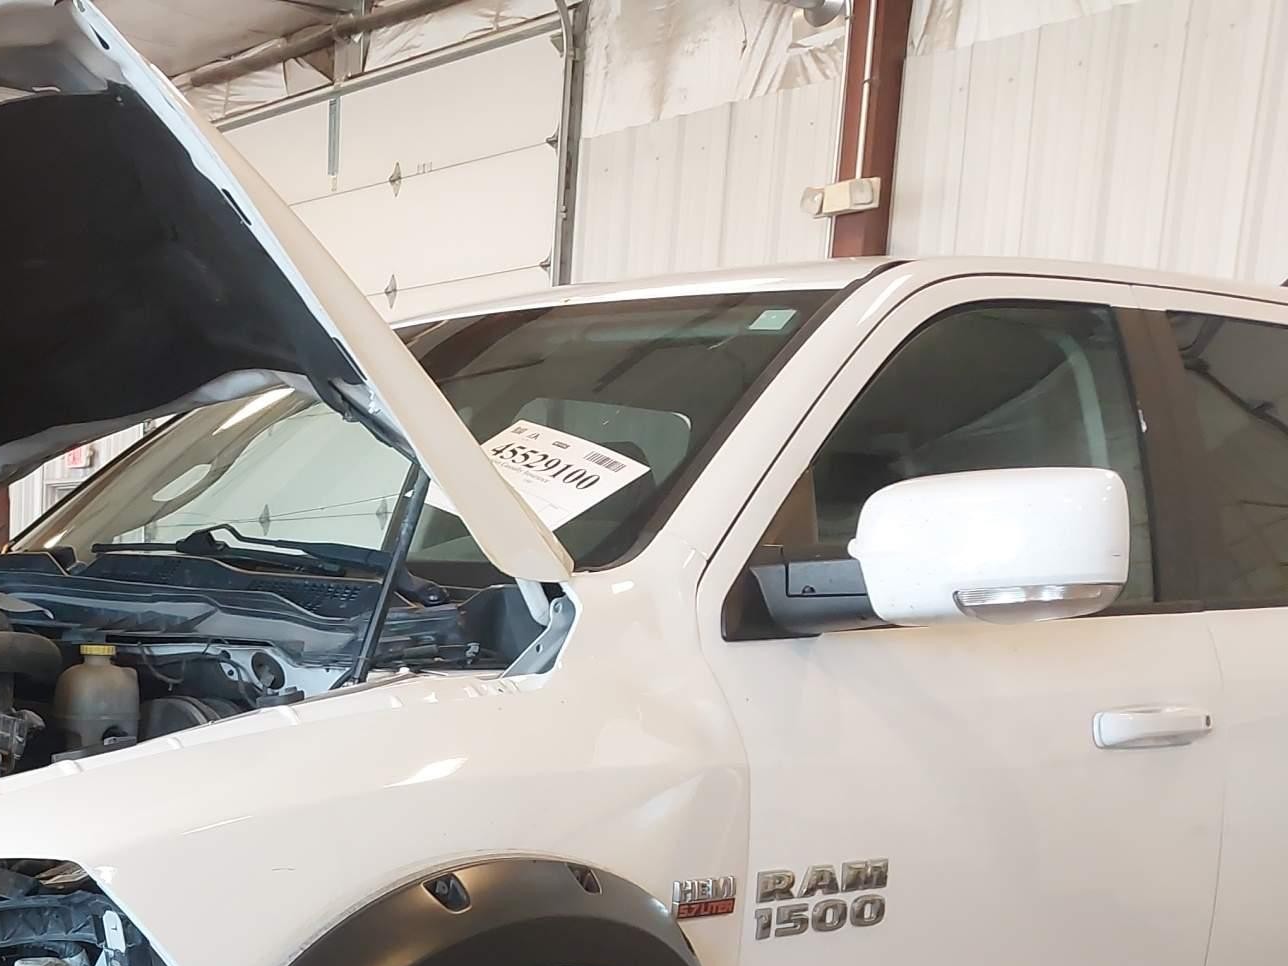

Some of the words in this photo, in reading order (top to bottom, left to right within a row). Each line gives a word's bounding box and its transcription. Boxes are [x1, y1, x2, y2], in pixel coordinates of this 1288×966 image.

[490, 442, 601, 490] 45529100
[673, 876, 736, 903] HEMI
[756, 858, 889, 903] RAM
[680, 904, 699, 917] 5.7
[700, 901, 733, 915] LITER
[754, 894, 887, 940] 1500
